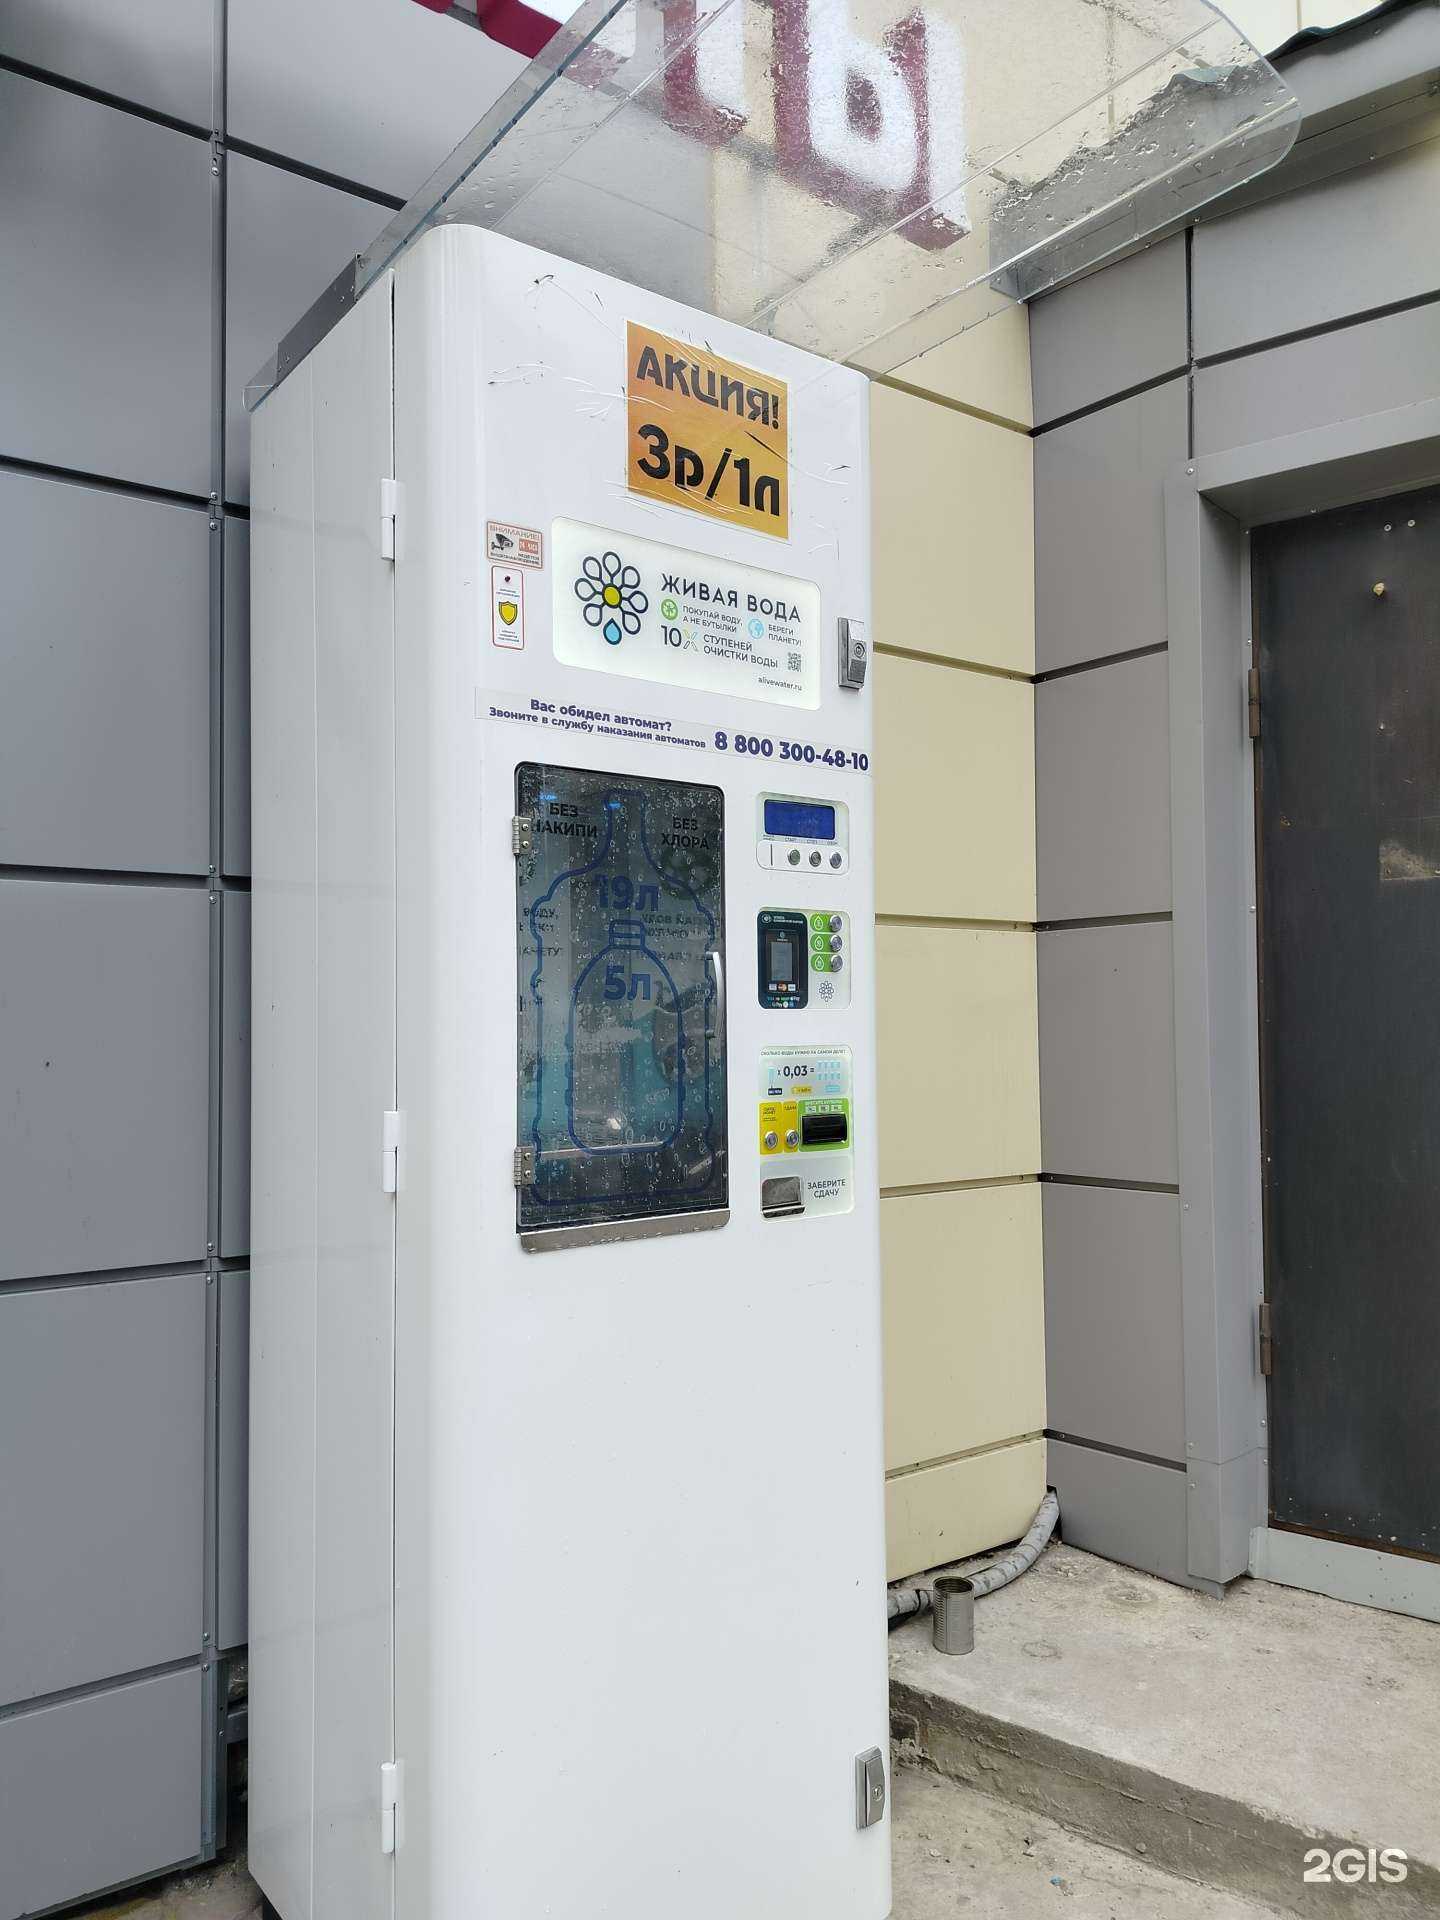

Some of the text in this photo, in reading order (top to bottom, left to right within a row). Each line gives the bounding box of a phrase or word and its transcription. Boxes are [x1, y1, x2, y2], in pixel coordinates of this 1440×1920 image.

[636, 345, 779, 430] АКЦИЯ!
[661, 573, 801, 623] ЖИВАЯ ВОДА
[682, 605, 743, 627] ПОКУПАЙ ВОДУ,
[691, 617, 700, 625] НЕ
[702, 620, 737, 633] БУТЫЛКИ
[768, 624, 794, 636] БЕРЕГИ
[703, 634, 753, 652] СТУПЕНЕЙ
[703, 645, 778, 669] ОЧИСТКИ ВОДЫ
[758, 676, 803, 691] alivewater.ru
[530, 699, 672, 732] Вас обидел автомат?
[489, 706, 706, 748] Звоните в службу наказания автоматов
[714, 731, 869, 771] 8 800 300-48-10
[550, 803, 578, 818] БЕЗ
[672, 816, 698, 831] БЕЗ
[661, 832, 710, 850] ХЛОРА
[783, 1065, 808, 1079] 0,03
[807, 1179, 846, 1190] ЗАБЕРИТЕ
[813, 1188, 840, 1198] СДАЧУ
